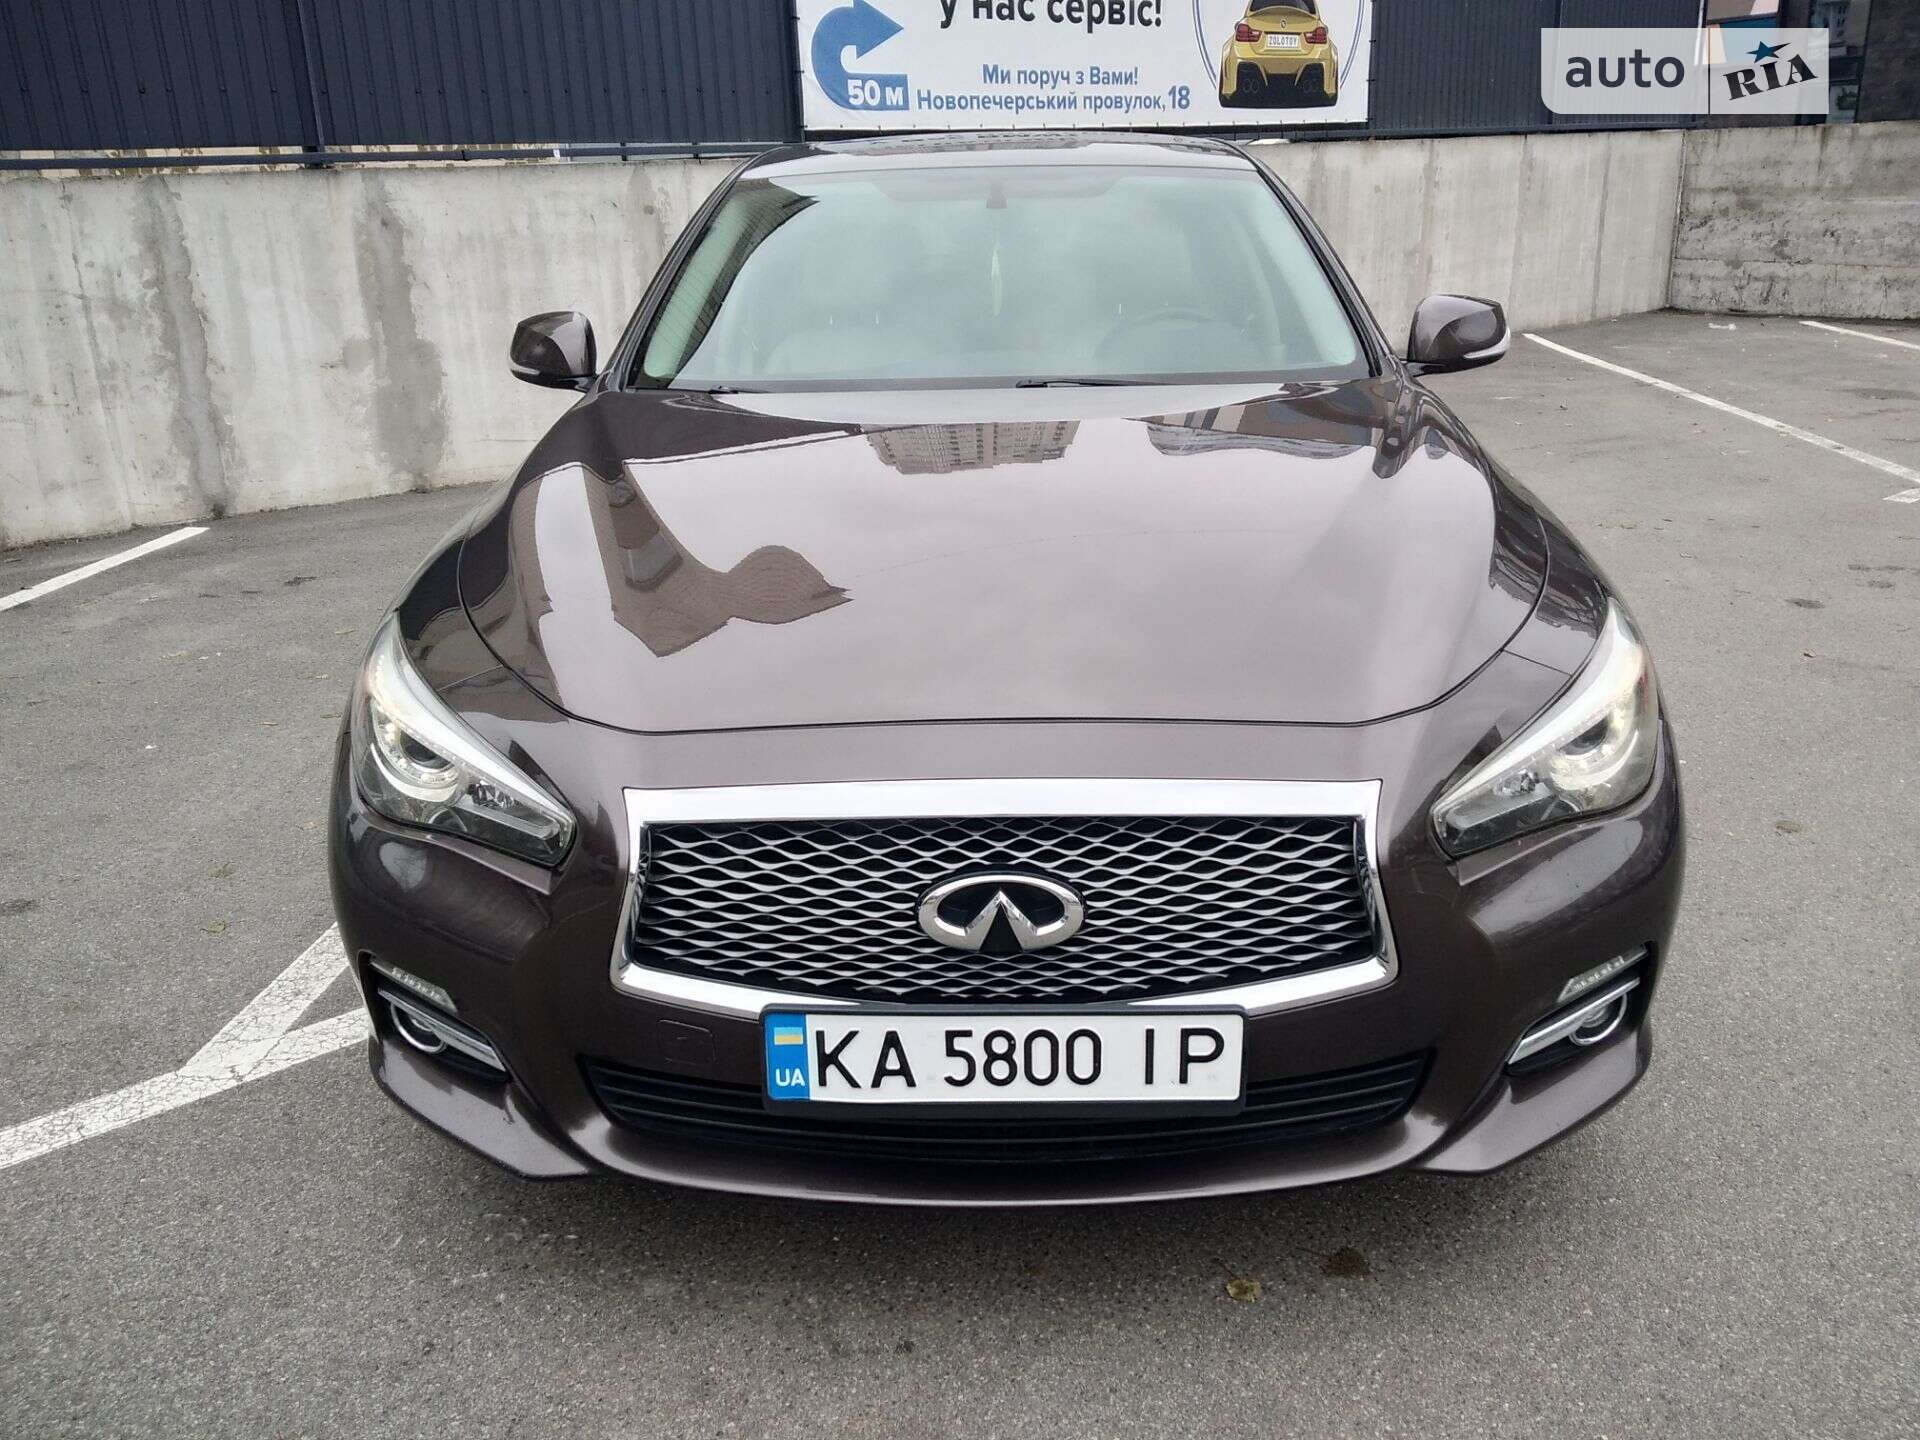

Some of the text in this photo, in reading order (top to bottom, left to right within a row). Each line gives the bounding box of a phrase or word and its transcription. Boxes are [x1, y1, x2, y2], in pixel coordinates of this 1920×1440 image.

[937, 0, 1162, 33] у нас сервіс!
[982, 64, 1011, 84] Ми
[1017, 68, 1070, 89] поруч
[1089, 66, 1139, 86] Вами!
[847, 79, 881, 106] 50
[916, 85, 1190, 114] Новопечерський провулок, 18
[815, 1027, 1225, 1089] KA 5800 IP
[775, 1068, 806, 1088] UA
